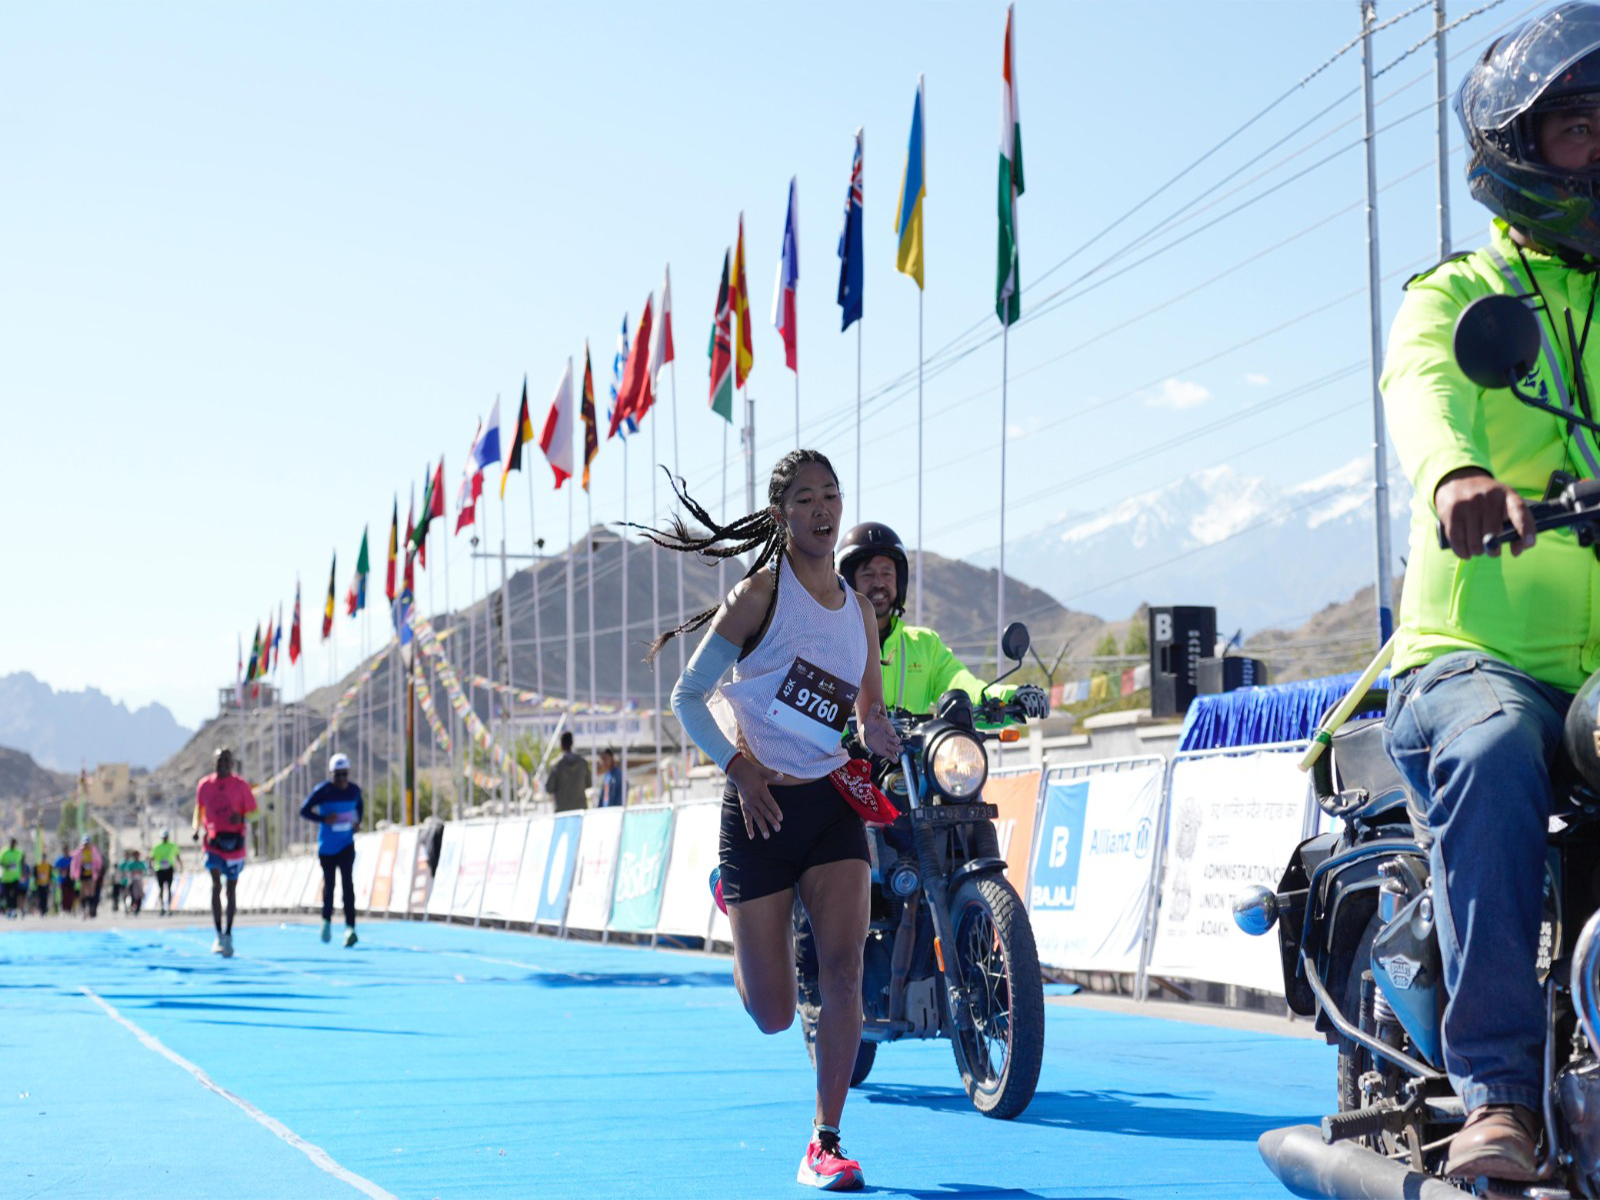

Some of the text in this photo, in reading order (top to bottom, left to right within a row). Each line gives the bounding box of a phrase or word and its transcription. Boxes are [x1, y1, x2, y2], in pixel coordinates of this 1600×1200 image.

[1155, 613, 1172, 641] B
[782, 678, 797, 698] 42K
[795, 688, 839, 723] 9760
[1090, 829, 1131, 856] Allianz
[1203, 864, 1272, 882] ADMINISTRATION
[1033, 885, 1077, 907] BAJAJ
[1200, 893, 1225, 909] UNION
[1196, 920, 1230, 937] LADAKH
